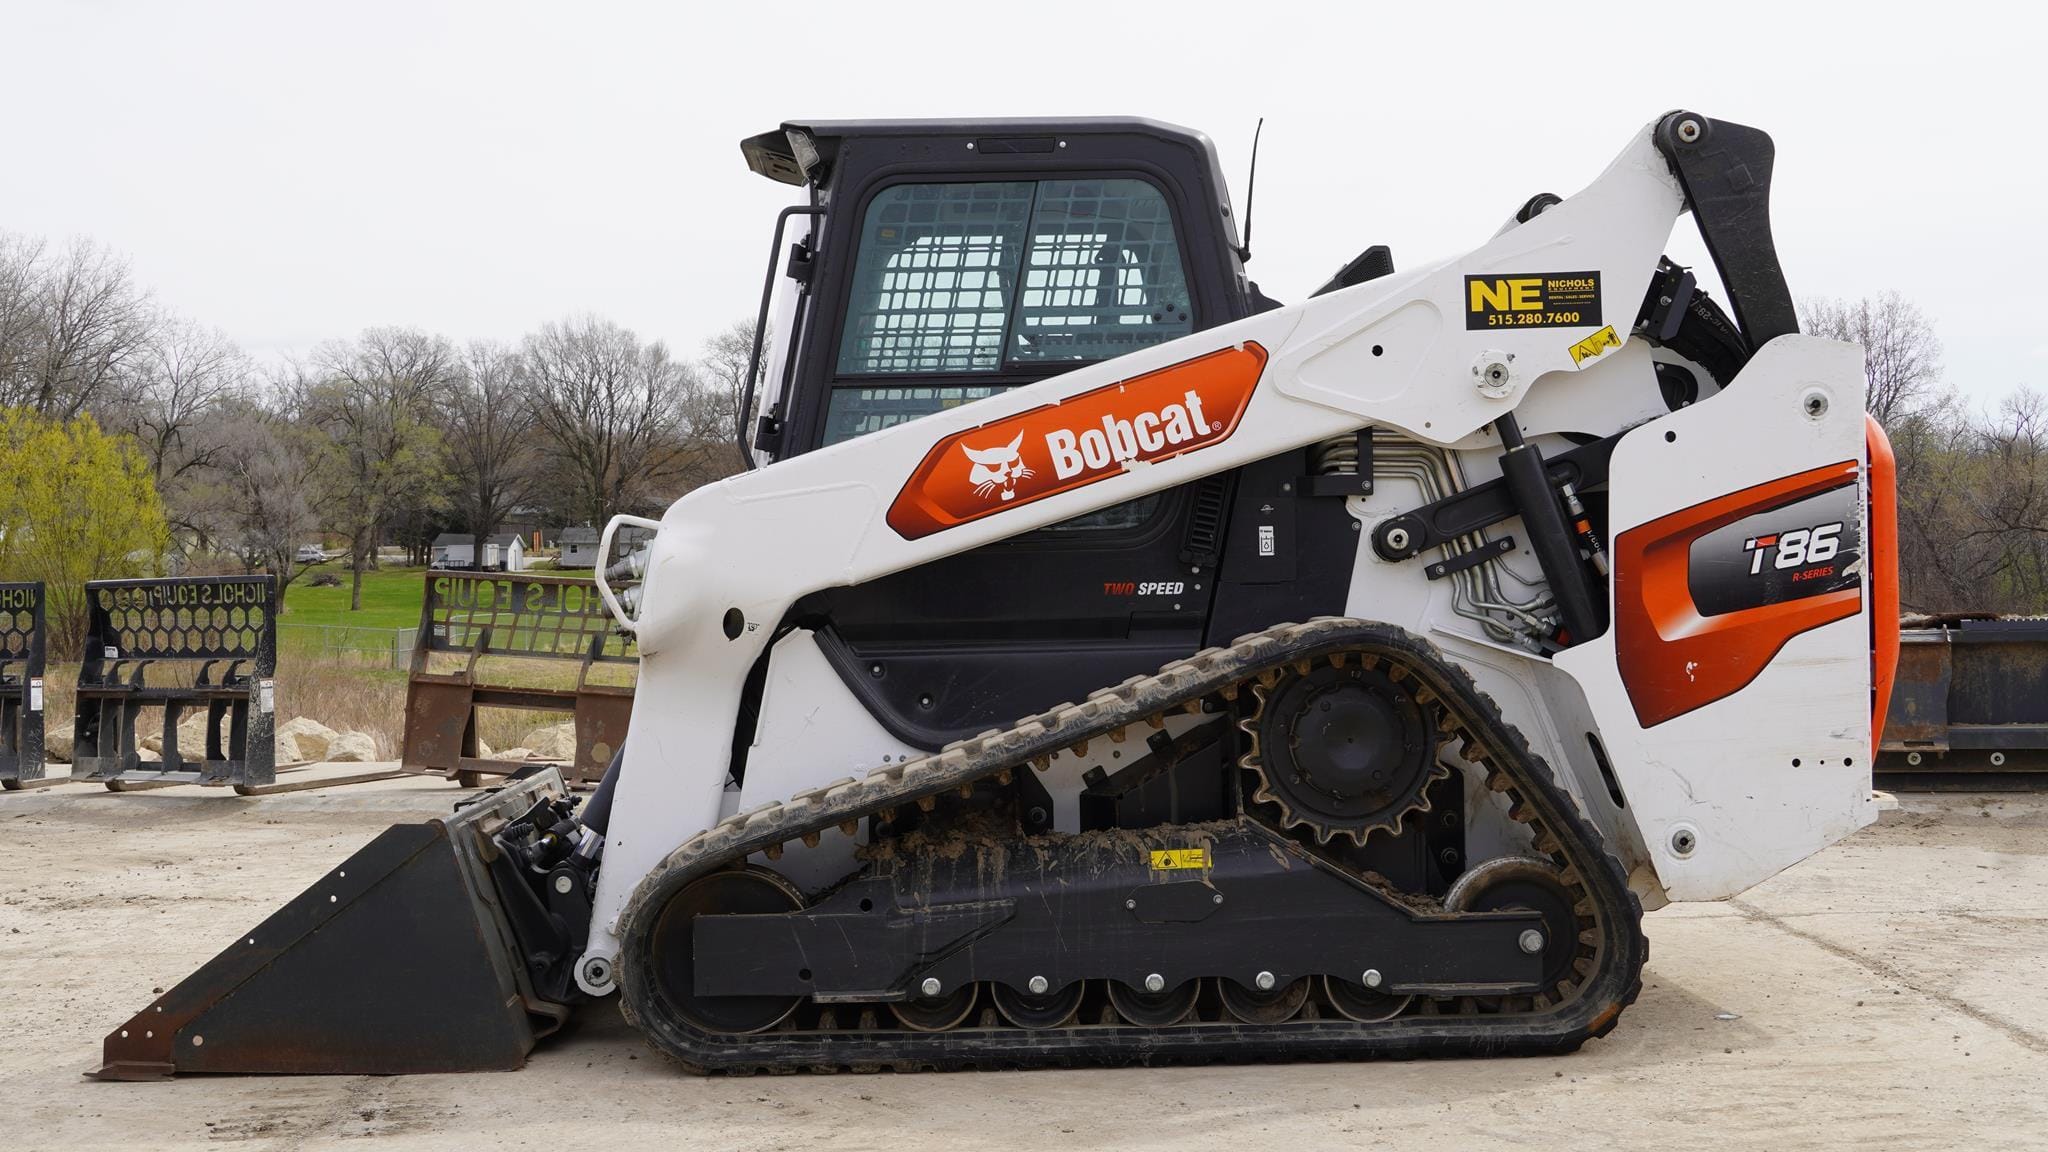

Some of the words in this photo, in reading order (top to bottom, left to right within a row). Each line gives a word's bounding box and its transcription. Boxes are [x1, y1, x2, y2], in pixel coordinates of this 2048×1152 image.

[1547, 278, 1595, 288] NICHOLS
[1470, 278, 1544, 312] NE
[1488, 312, 1580, 326] 515.280.7600
[1045, 389, 1211, 481] Bobcat
[1743, 521, 1843, 575] T86
[1792, 566, 1834, 582] R-SERIES
[1104, 583, 1136, 596] TWO
[1137, 582, 1184, 595] SPEED
